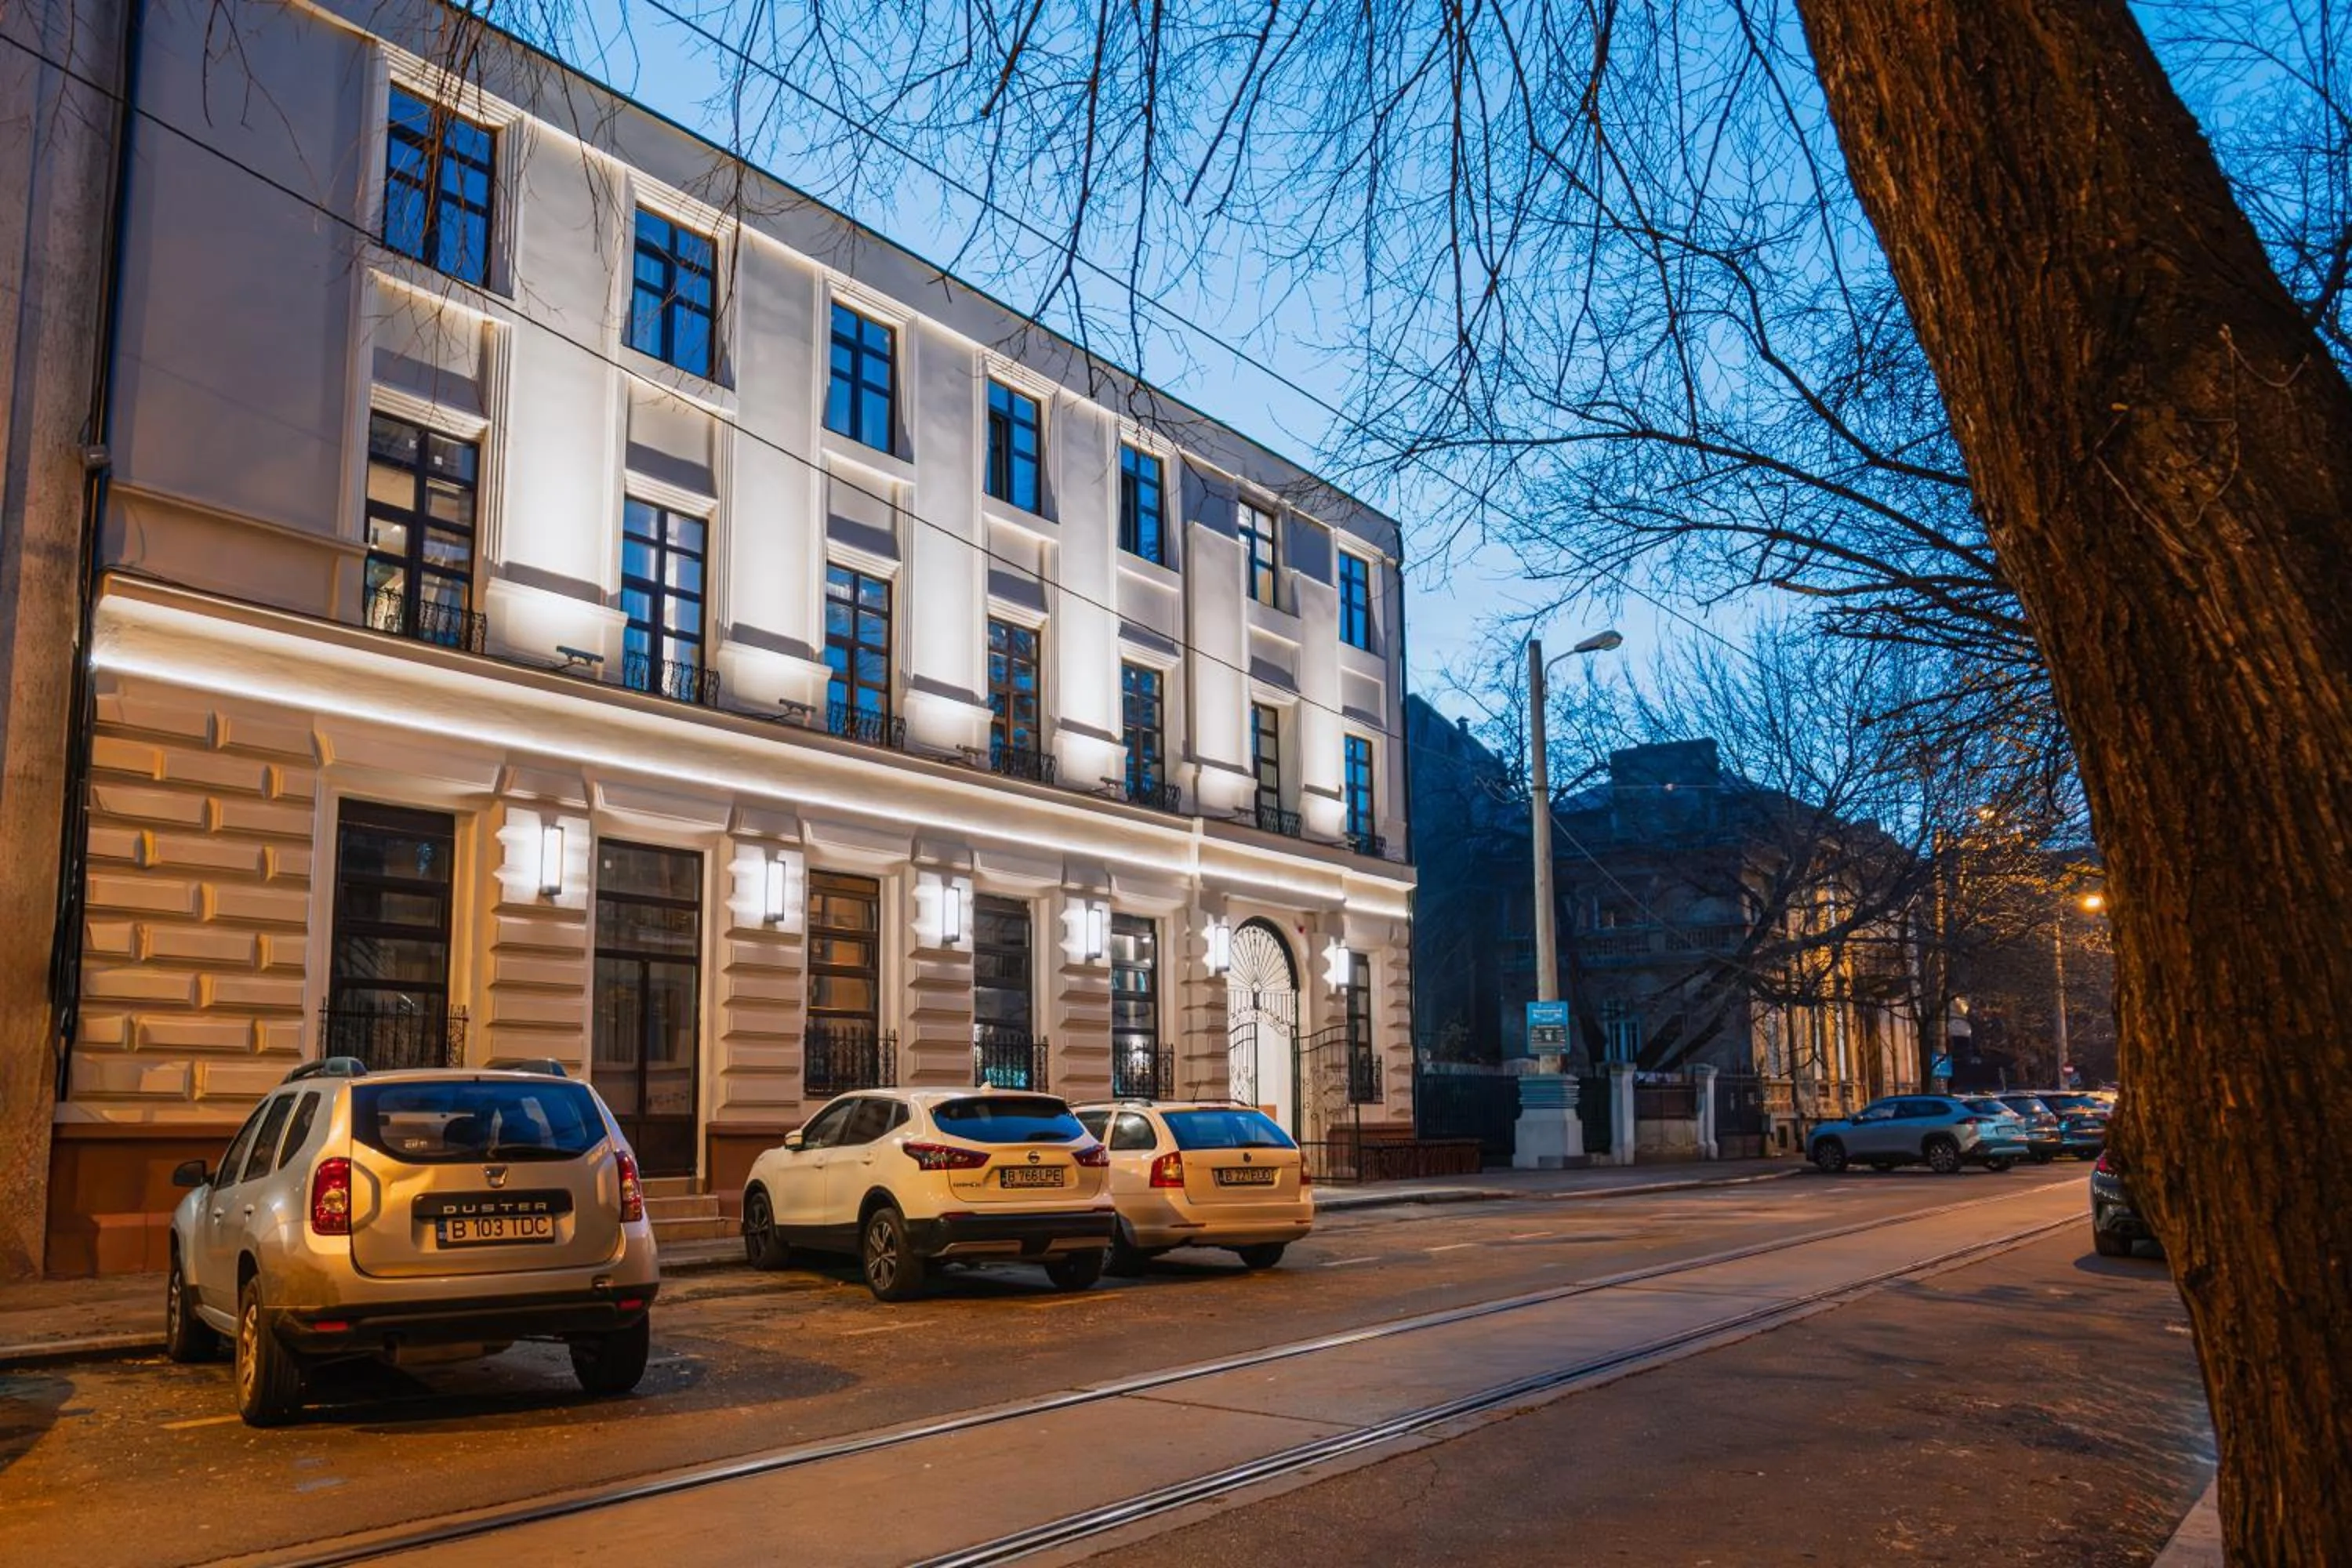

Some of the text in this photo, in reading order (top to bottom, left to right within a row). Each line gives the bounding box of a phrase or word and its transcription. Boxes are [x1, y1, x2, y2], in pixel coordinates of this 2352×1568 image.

[1008, 1171, 1015, 1182] B
[1039, 1169, 1061, 1181] LPE
[443, 1202, 547, 1214] DUSTER
[452, 1216, 548, 1239] B 103 TDC
